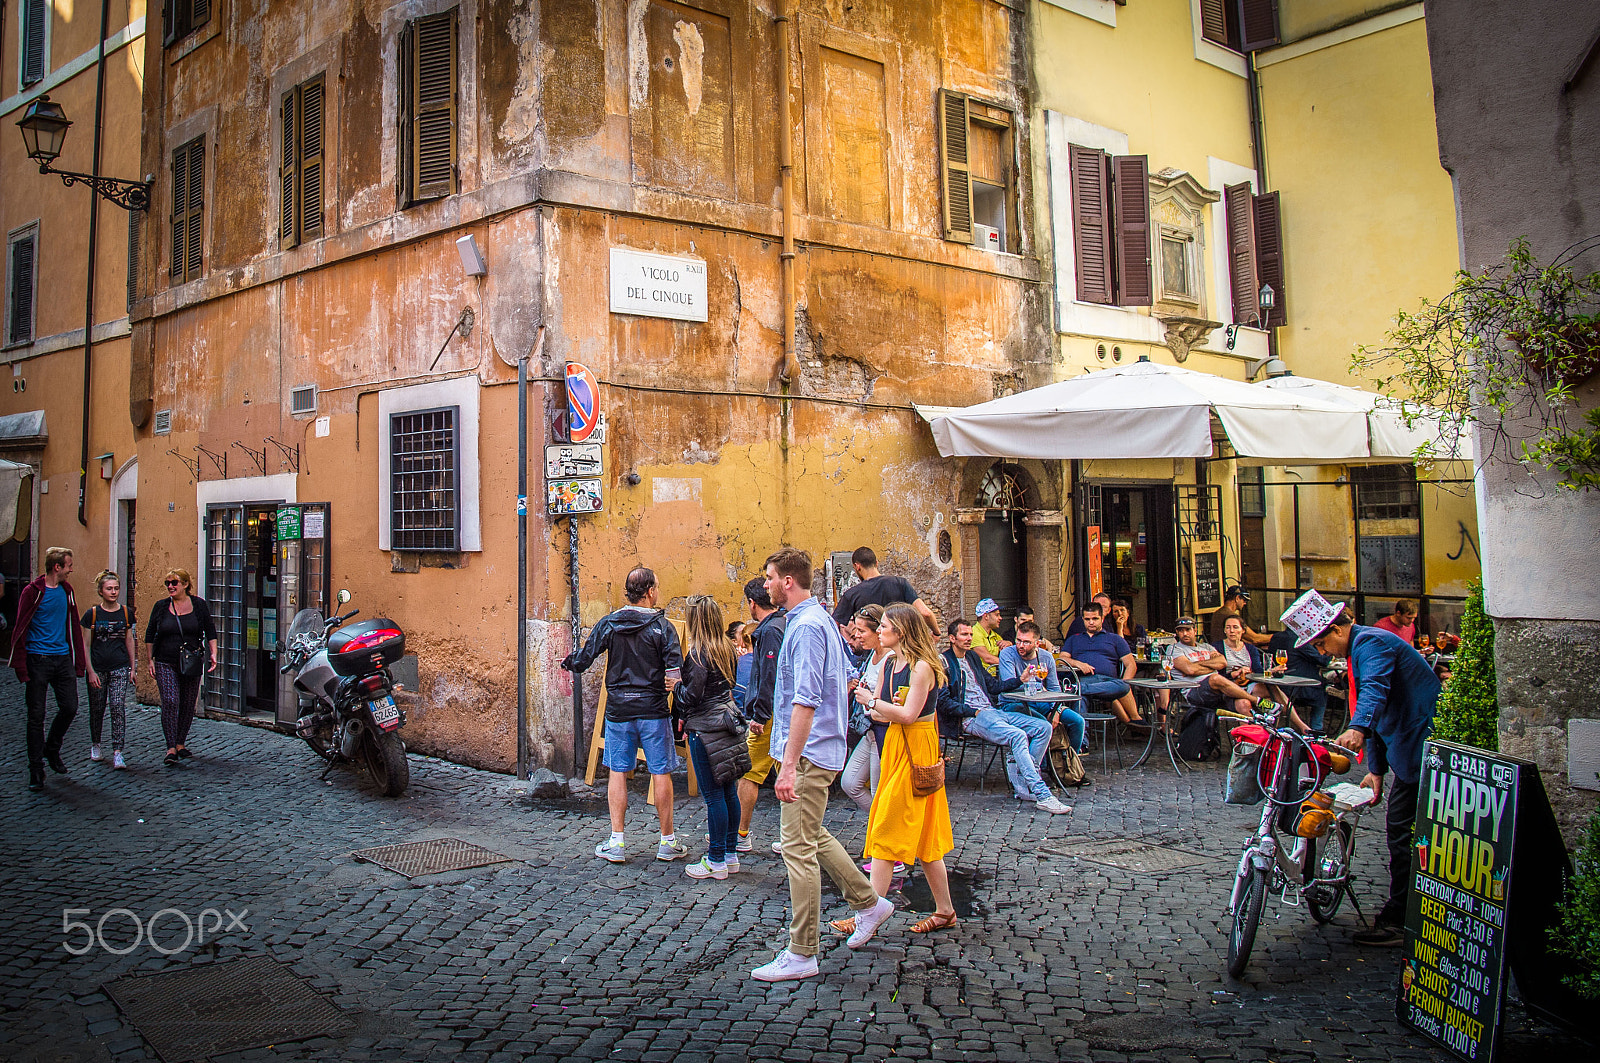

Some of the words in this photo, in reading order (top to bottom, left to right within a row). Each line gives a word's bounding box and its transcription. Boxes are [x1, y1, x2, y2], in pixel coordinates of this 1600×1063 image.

[627, 286, 647, 300] DEL
[652, 289, 694, 306] CINQUE
[641, 266, 680, 283] VICOLO
[1427, 769, 1508, 843] HAPPY
[1495, 781, 1509, 790] ZONE
[1428, 823, 1495, 898] HOUR
[1415, 873, 1456, 904] EVERYDAY
[1455, 891, 1474, 913] 4PM
[1480, 901, 1504, 927] 10PM
[1420, 896, 1446, 925] BEER
[1446, 910, 1464, 933] Pint
[1464, 916, 1486, 943] 3,50
[1414, 938, 1440, 969] WINE
[1439, 956, 1460, 980] Glass
[1460, 963, 1482, 992] 3,00
[1421, 919, 1457, 953] DRINKS
[1457, 937, 1479, 965] 5,00
[1418, 965, 1450, 998] SHOTS
[1449, 982, 1472, 1011] 2,00
[1407, 1004, 1415, 1020] 5
[1413, 1008, 1441, 1038] Bottles
[1442, 1022, 1469, 1054] 10,00
[1409, 984, 1445, 1020] PERONI
[1445, 1004, 1485, 1043] BUCKET
